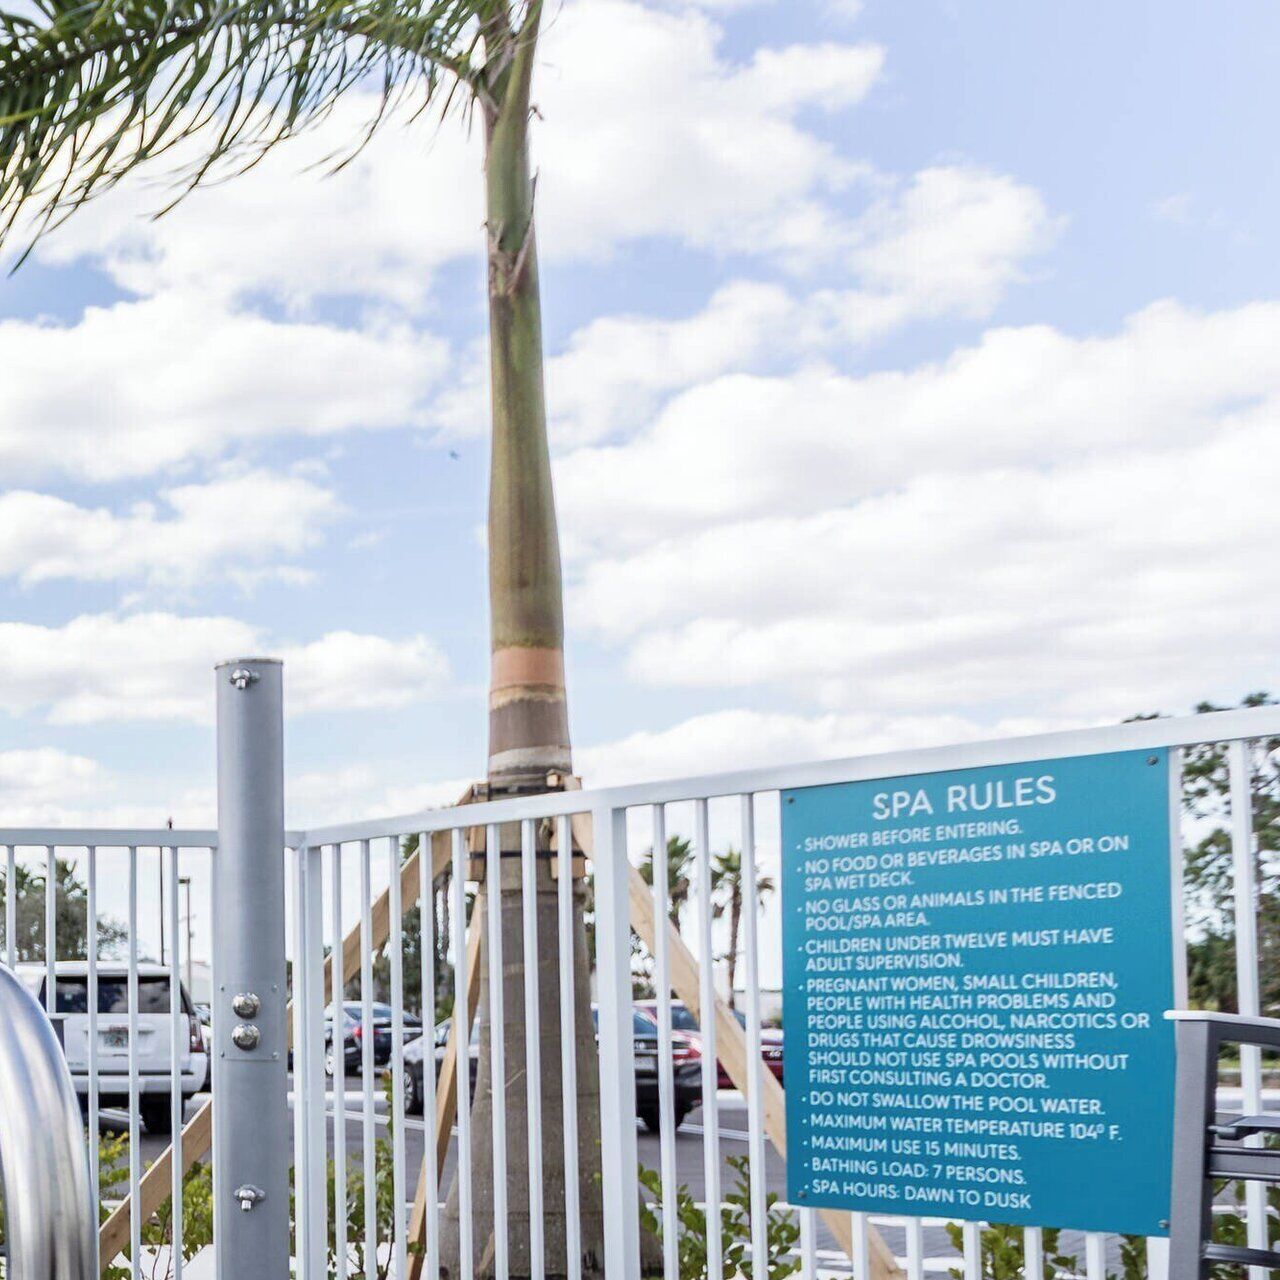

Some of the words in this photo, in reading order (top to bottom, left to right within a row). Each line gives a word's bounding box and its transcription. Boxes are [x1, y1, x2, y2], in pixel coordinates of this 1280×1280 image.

[872, 788, 933, 820] SPA
[947, 775, 1057, 812] RULES
[804, 832, 868, 852] SHOWER
[871, 826, 931, 846] BEFORE
[935, 818, 1022, 840] ENTERING.
[804, 858, 829, 874] NO
[831, 854, 878, 872] FOOD
[879, 852, 904, 869] OR
[907, 844, 1002, 867] BEVERAGES
[1006, 843, 1025, 859] IN
[1028, 840, 1063, 857] SPA
[1065, 837, 1094, 854] OR
[1096, 834, 1128, 852] ON
[804, 876, 832, 892] SPA
[834, 873, 866, 889] WET
[805, 898, 830, 914] NO
[831, 895, 881, 913] GLASS
[882, 894, 907, 910] OR
[909, 889, 985, 908] ANIMALS
[988, 889, 1007, 904] IN
[1009, 886, 1043, 902] THE
[1048, 881, 1122, 901] FENCED
[805, 913, 882, 931] POOL/SPA
[804, 936, 882, 954] CHILDREN
[885, 934, 943, 951] UNDER
[943, 931, 1007, 948] TWELVE
[1011, 928, 1060, 946] MUST
[1063, 926, 1113, 944] HAVE
[805, 955, 853, 971] ADULT
[855, 952, 963, 970] SUPERVISION.
[806, 976, 889, 993] PREGNANT
[888, 975, 959, 992] WOMEN,
[962, 974, 1019, 990] SMALL
[1018, 971, 1118, 989] CHILDREN,
[806, 995, 862, 1011] PEOPLE
[865, 995, 906, 1010] WITH
[909, 993, 972, 1010] HEALTH
[976, 992, 1070, 1009] PROBLEMS
[1072, 991, 1116, 1008] AND
[807, 1013, 863, 1029] PEOPLE
[866, 1013, 917, 1029] USING
[918, 1013, 1005, 1030] ALCOHOL,
[1009, 1011, 1117, 1029] NARCOTICS
[1119, 1012, 1150, 1028] OR
[807, 1032, 860, 1047] DRUGS
[861, 1032, 901, 1047] THAT
[902, 1032, 957, 1048] CAUSE
[960, 1032, 1075, 1049] DROWSINESS
[808, 1050, 871, 1066] SHOULD
[873, 1051, 907, 1066] NOT
[910, 1051, 941, 1067] USE
[945, 1051, 976, 1067] SPA
[979, 1052, 1039, 1069] POOLS
[1041, 1052, 1129, 1070] WITHOUT
[809, 1068, 847, 1084] FIRST
[848, 1069, 952, 1087] CONSULTING
[954, 1071, 968, 1086] A
[809, 1090, 834, 1105] DO
[836, 1091, 869, 1106] NOT
[871, 1092, 950, 1109] SWALLOW
[950, 1094, 984, 1111] THE
[988, 1095, 1038, 1113] POOL
[810, 1113, 886, 1130] MAXIMUM
[889, 1116, 942, 1132] WATER
[944, 1117, 1065, 1138] TEMPERATURE
[1108, 1124, 1122, 1140] F.
[811, 1134, 887, 1152] MAXIMUM
[891, 1139, 921, 1155] USE
[924, 1140, 940, 1156] 15
[943, 1141, 1021, 1160] MINUTES.
[811, 1156, 878, 1175] BATHING
[881, 1161, 928, 1178] LOAD:
[932, 1163, 942, 1178] 7
[945, 1164, 1026, 1184] PERSONS.
[812, 1178, 840, 1194] SPA
[842, 1181, 900, 1199] HOURS:
[904, 1185, 954, 1203] DAWN
[956, 1188, 980, 1205] TO
[983, 1190, 1031, 1209] DUSK
